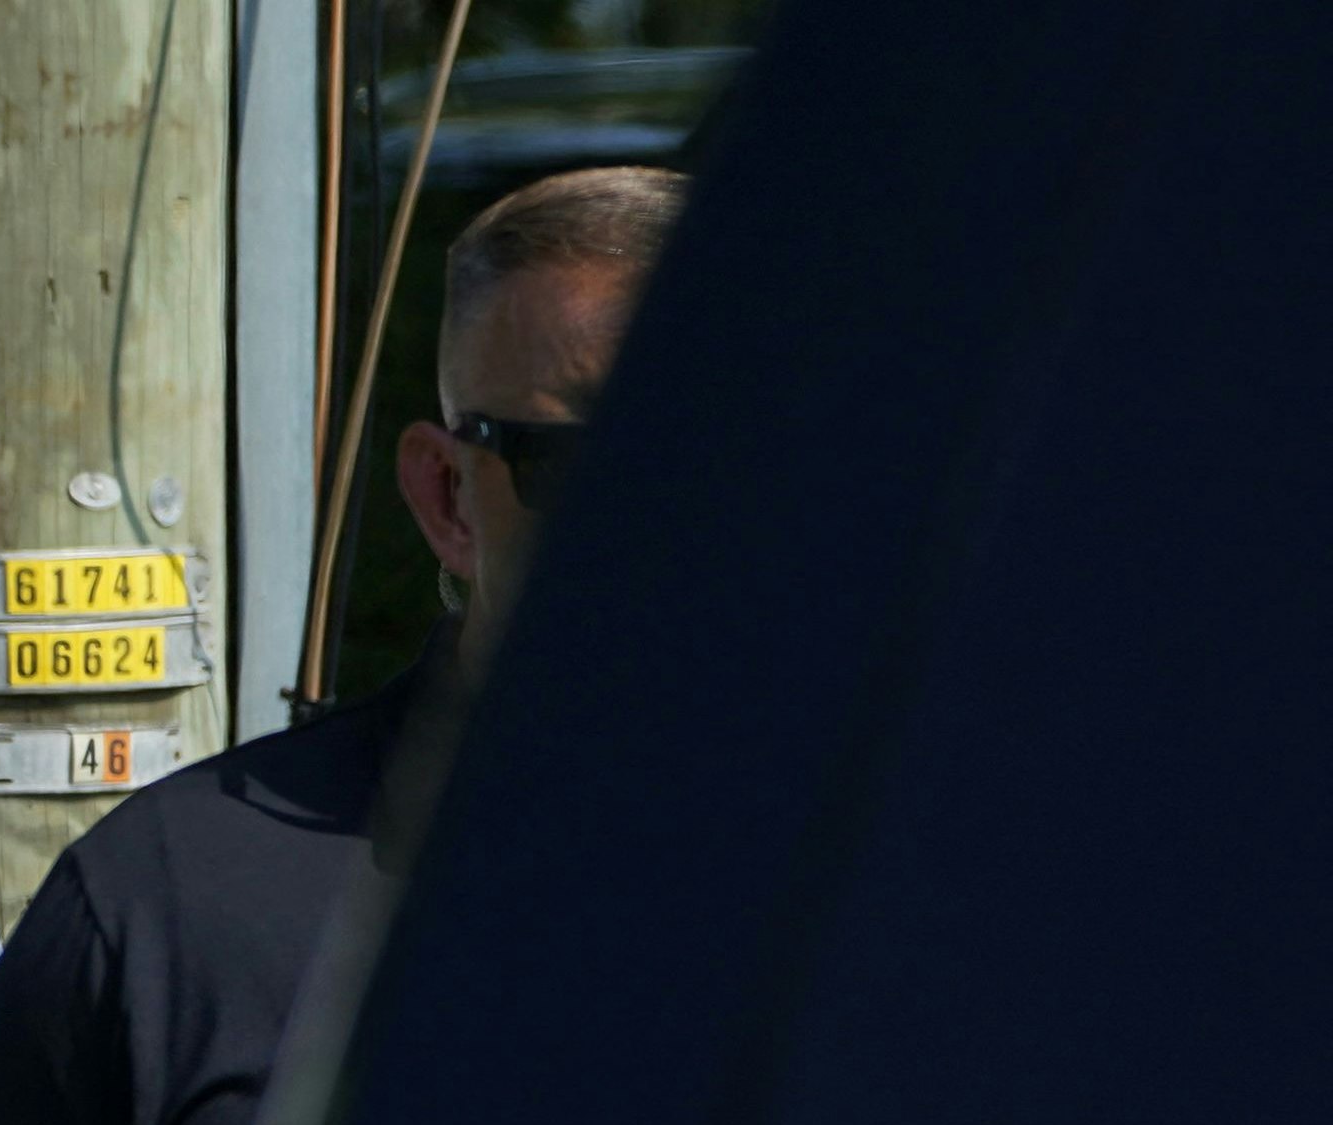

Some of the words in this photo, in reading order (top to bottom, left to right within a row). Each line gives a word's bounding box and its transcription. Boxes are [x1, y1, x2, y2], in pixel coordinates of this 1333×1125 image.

[15, 563, 158, 607] 61741
[17, 634, 159, 679] 06624
[81, 738, 127, 775] 46
